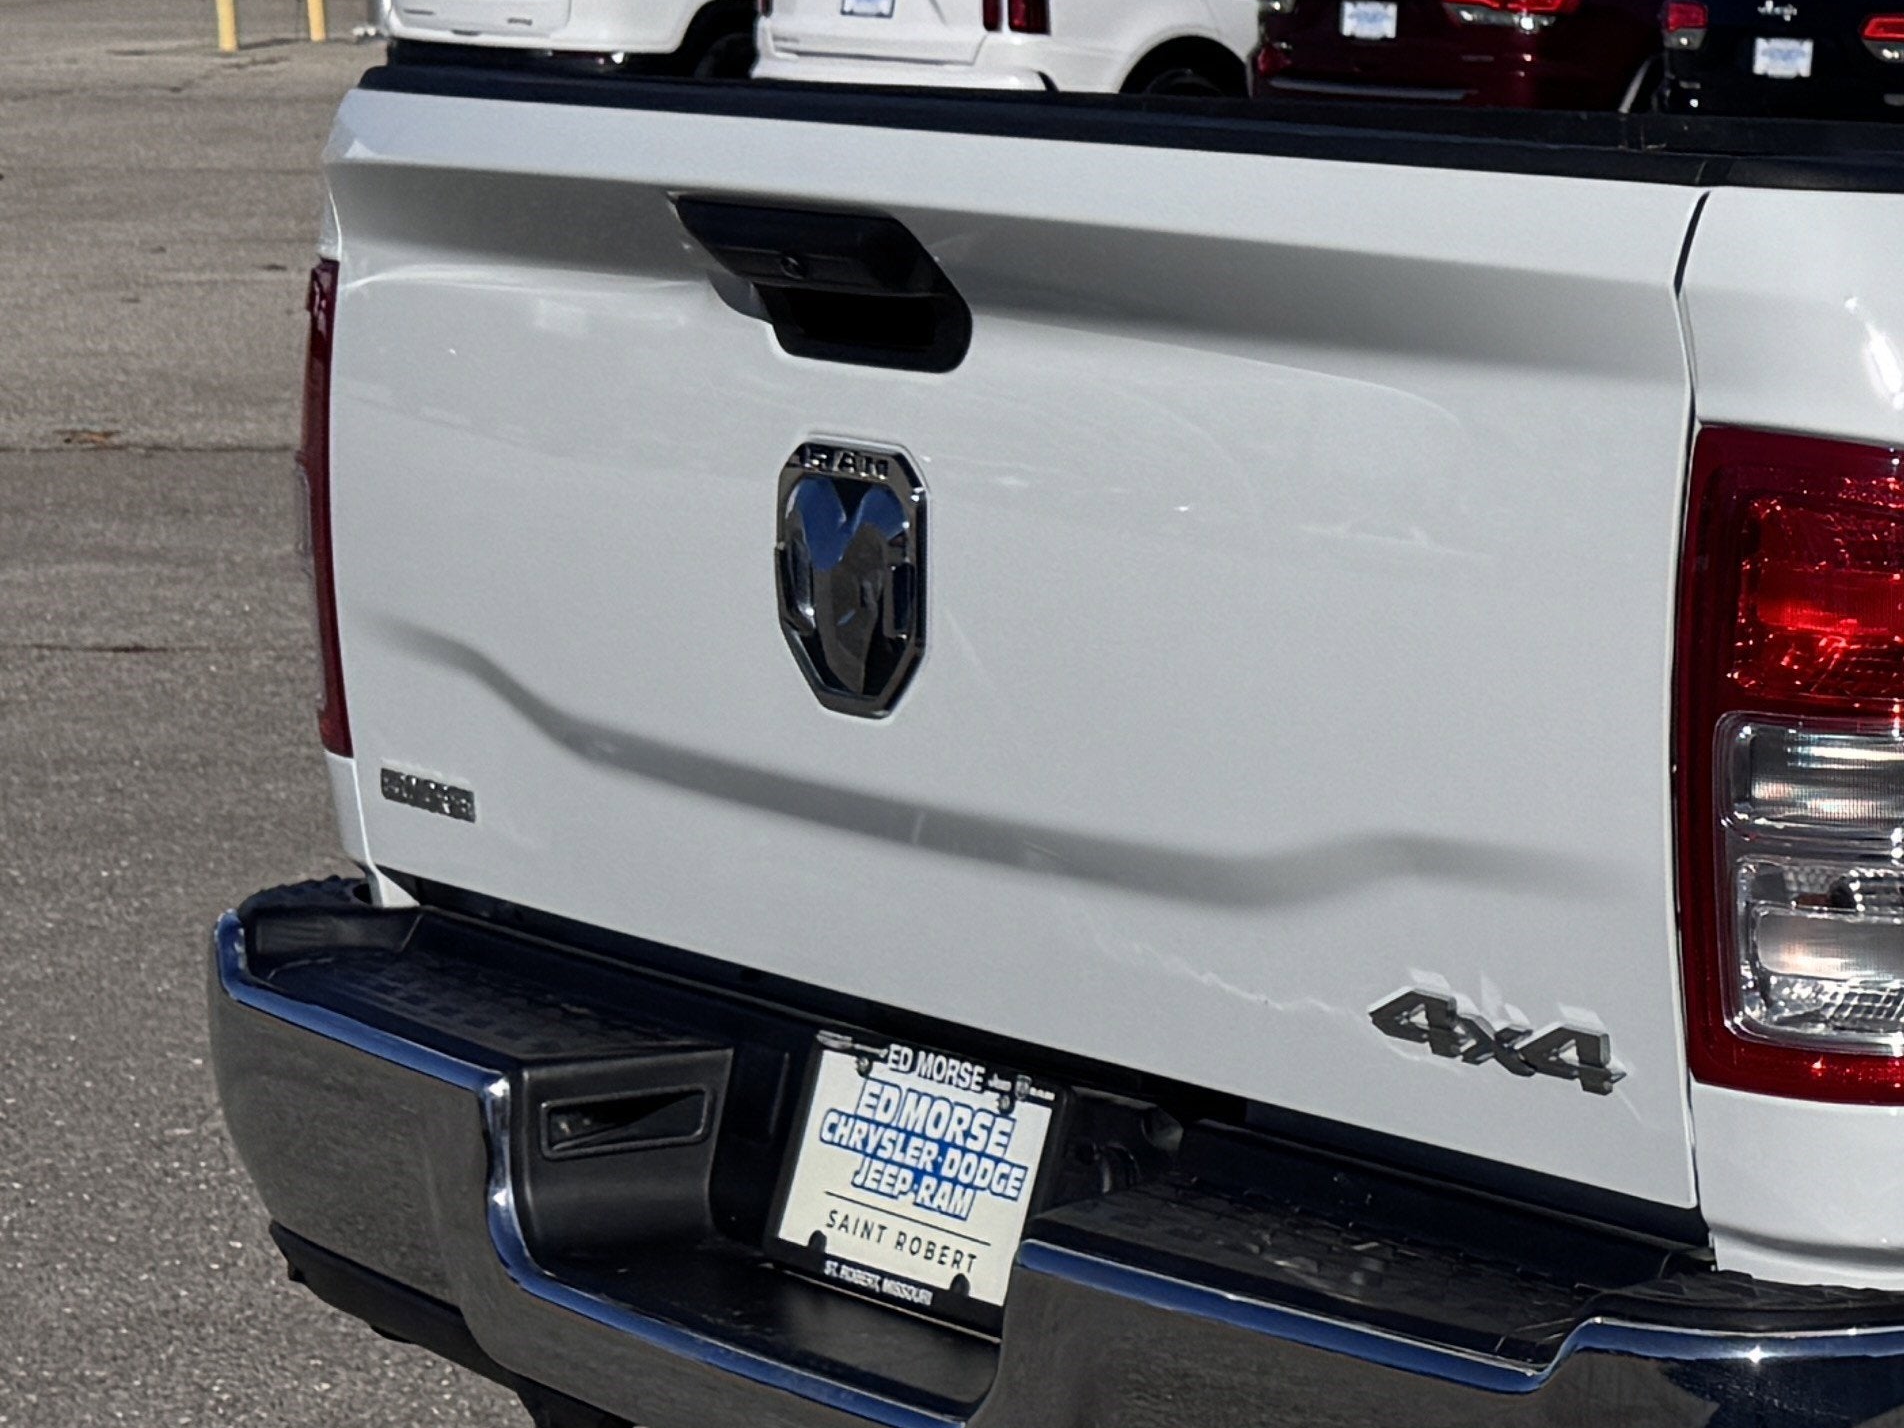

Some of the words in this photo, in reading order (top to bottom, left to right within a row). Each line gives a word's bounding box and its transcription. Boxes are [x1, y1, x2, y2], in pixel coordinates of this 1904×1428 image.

[888, 1043, 914, 1074] ED
[916, 1050, 986, 1092] MORSE
[857, 1079, 902, 1125] ED
[899, 1089, 1015, 1159] MORSE
[826, 1209, 888, 1244] SAINT
[895, 1231, 977, 1274] ROBERT
